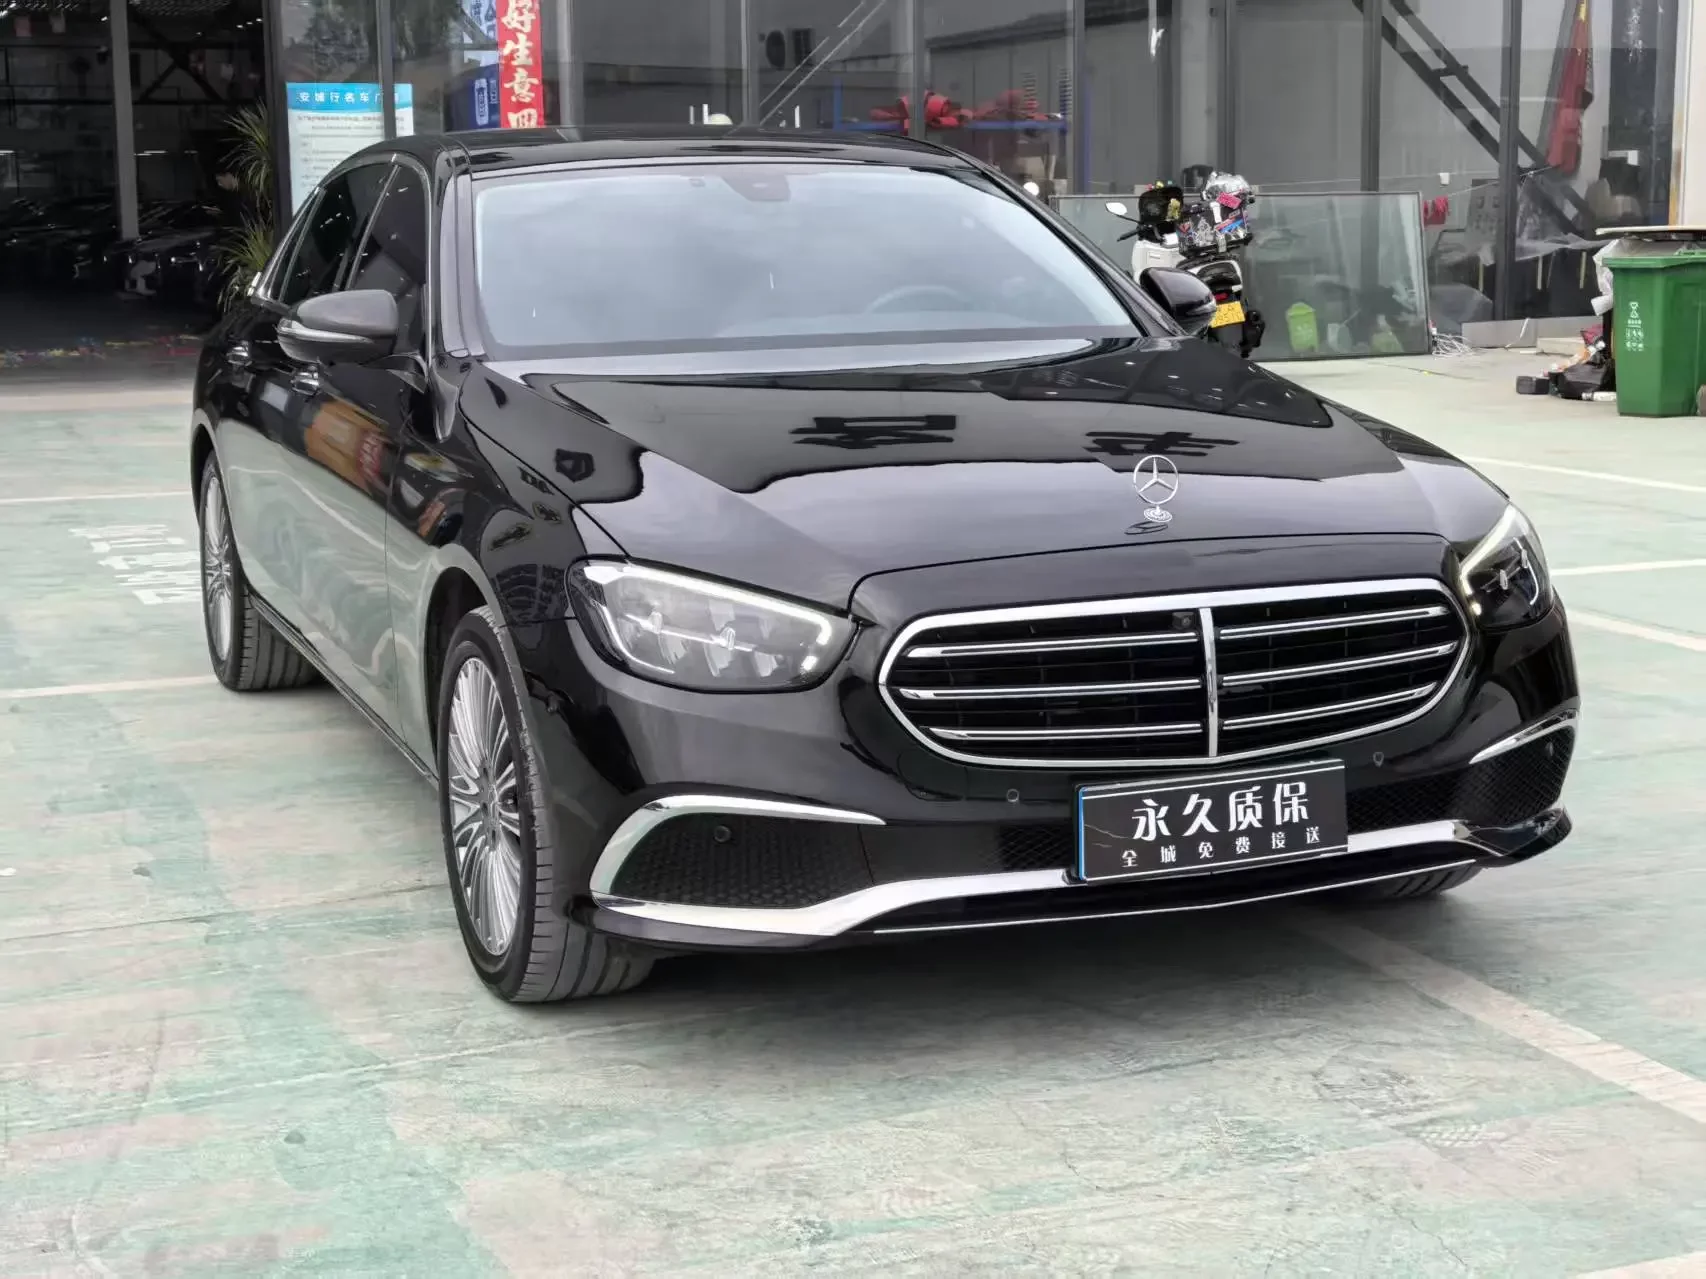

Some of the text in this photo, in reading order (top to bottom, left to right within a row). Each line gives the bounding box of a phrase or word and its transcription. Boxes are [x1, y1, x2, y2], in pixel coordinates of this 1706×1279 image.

[1131, 781, 1310, 841] 永久质保
[1121, 826, 1321, 868] 全城免费接送
